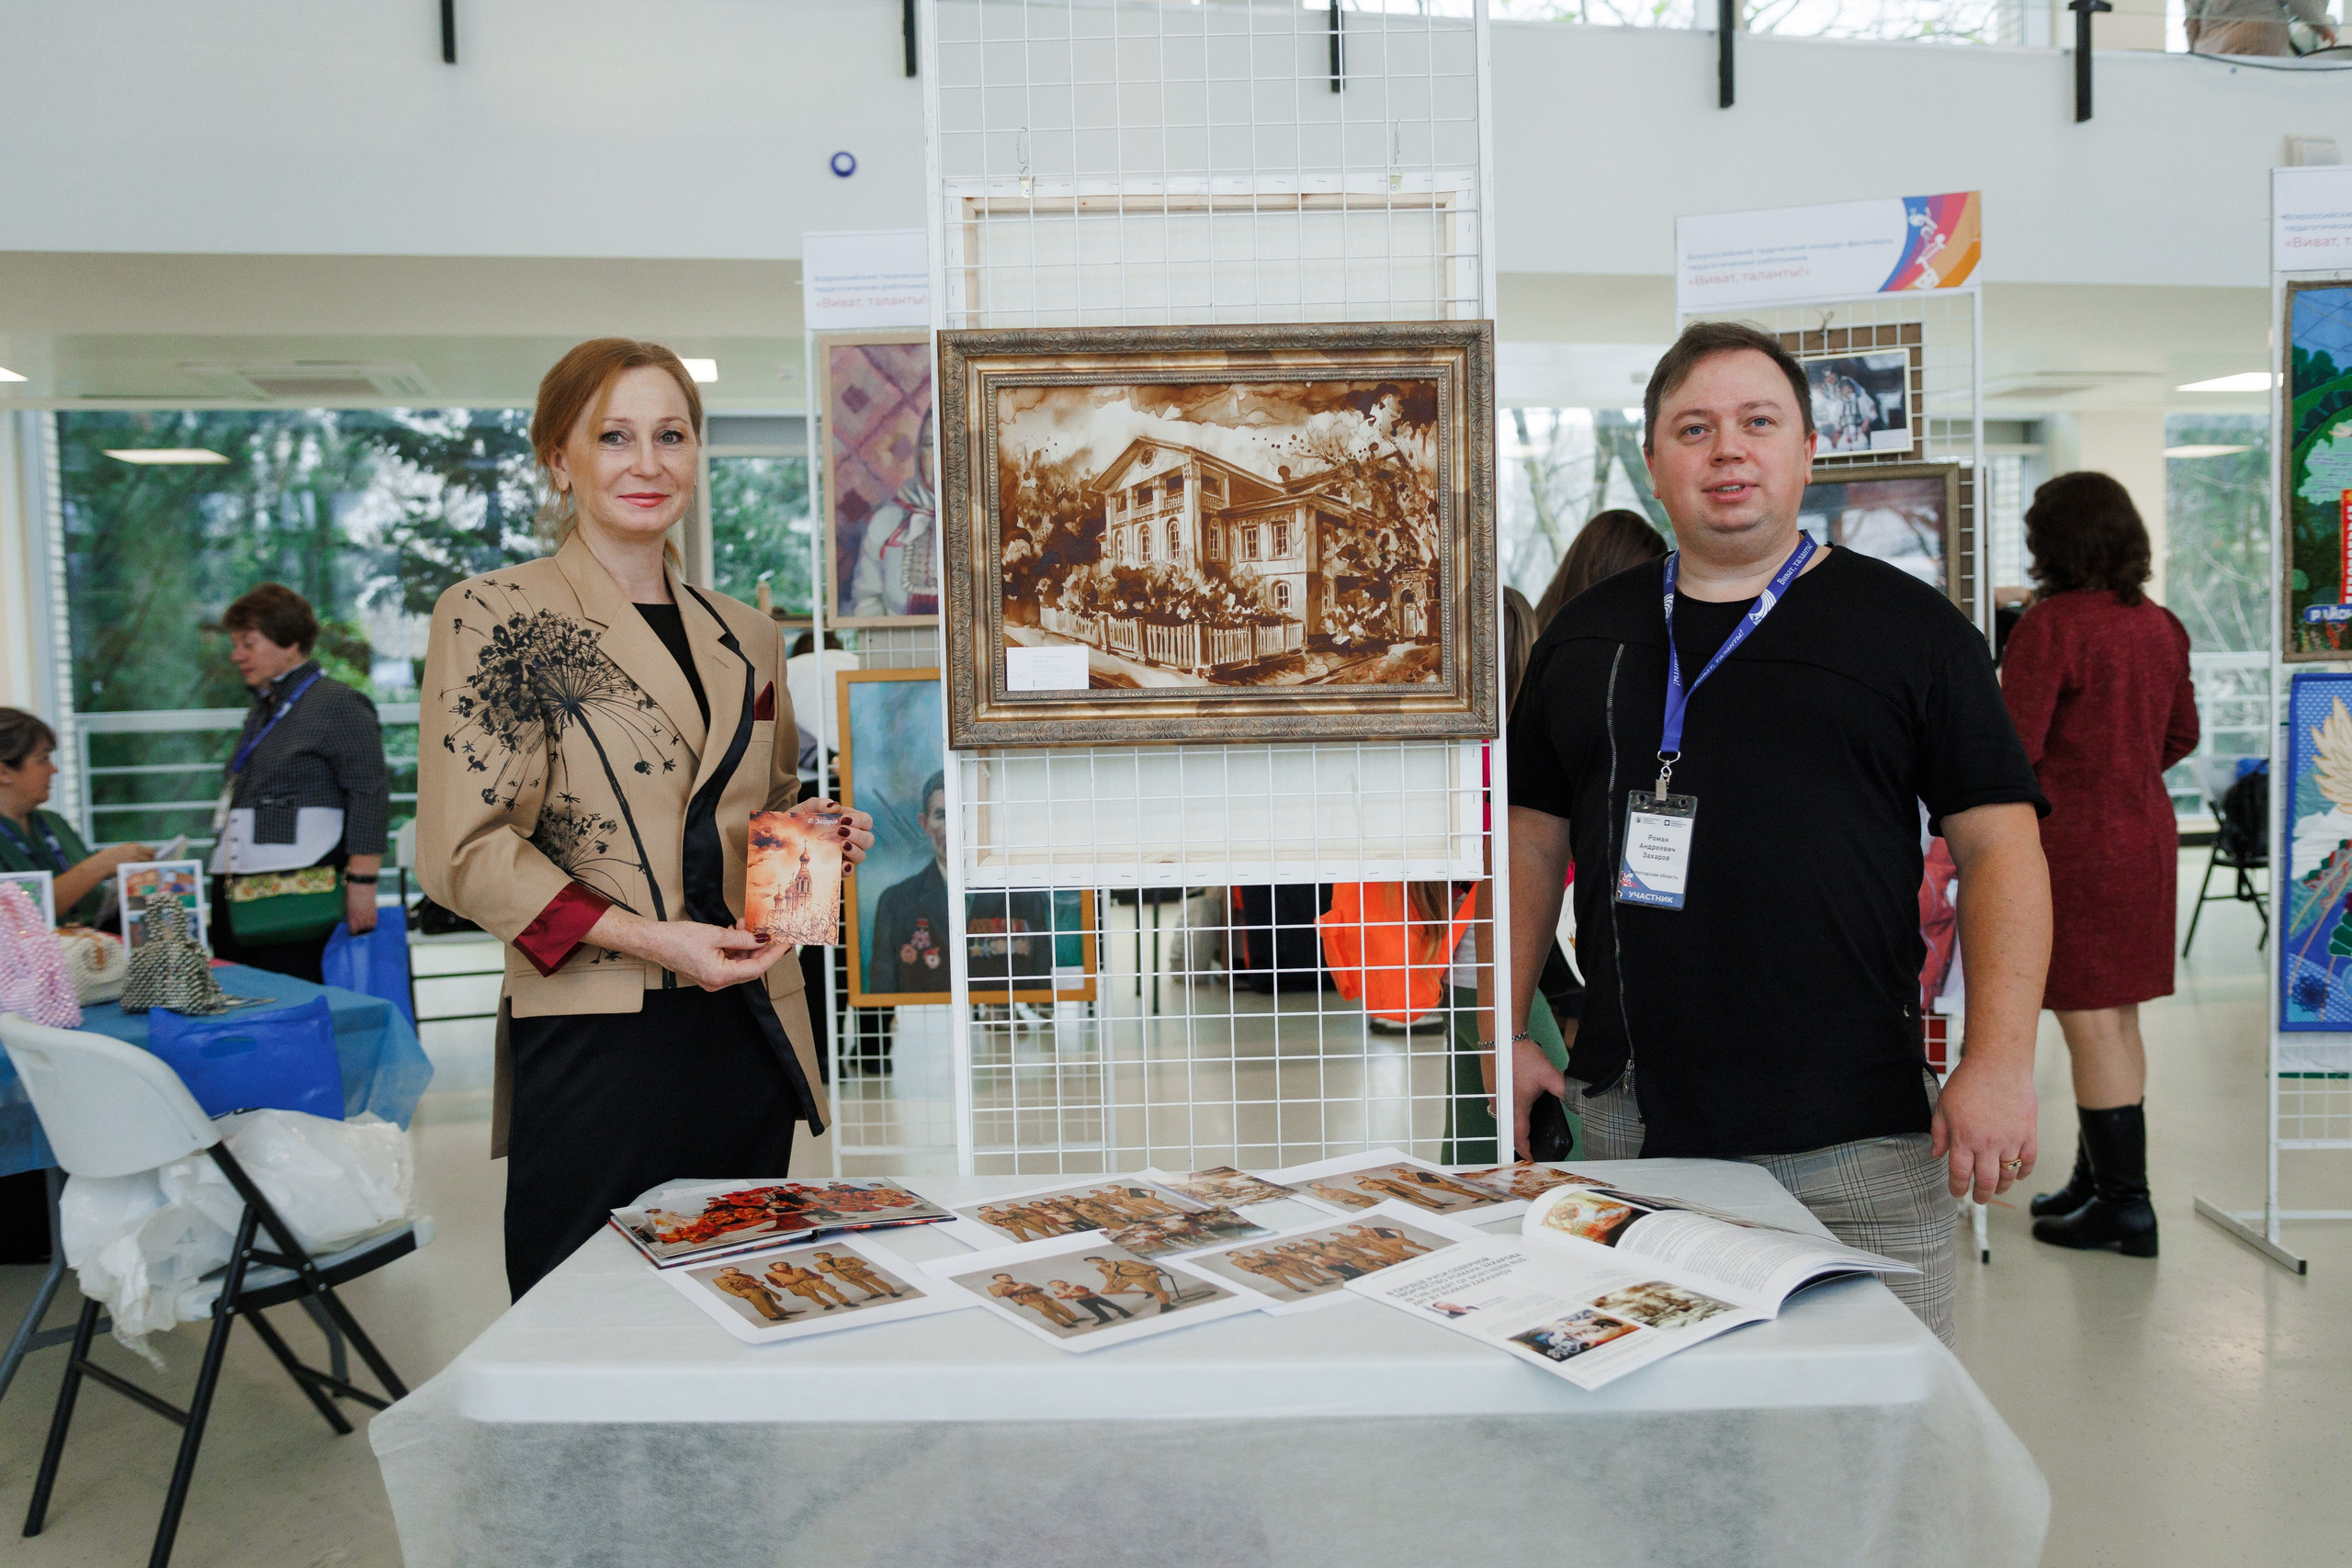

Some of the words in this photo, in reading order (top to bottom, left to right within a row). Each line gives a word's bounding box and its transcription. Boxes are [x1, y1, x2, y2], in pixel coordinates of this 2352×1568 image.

[1776, 564, 1798, 587] Виват,
[1792, 541, 1815, 567] таланты!
[1714, 628, 1746, 663] таланты!
[1648, 834, 1669, 842] Роман
[1639, 842, 1676, 852] Андреевич
[1643, 852, 1670, 862] Захаров
[1628, 891, 1673, 903] УЧАСТНИК
